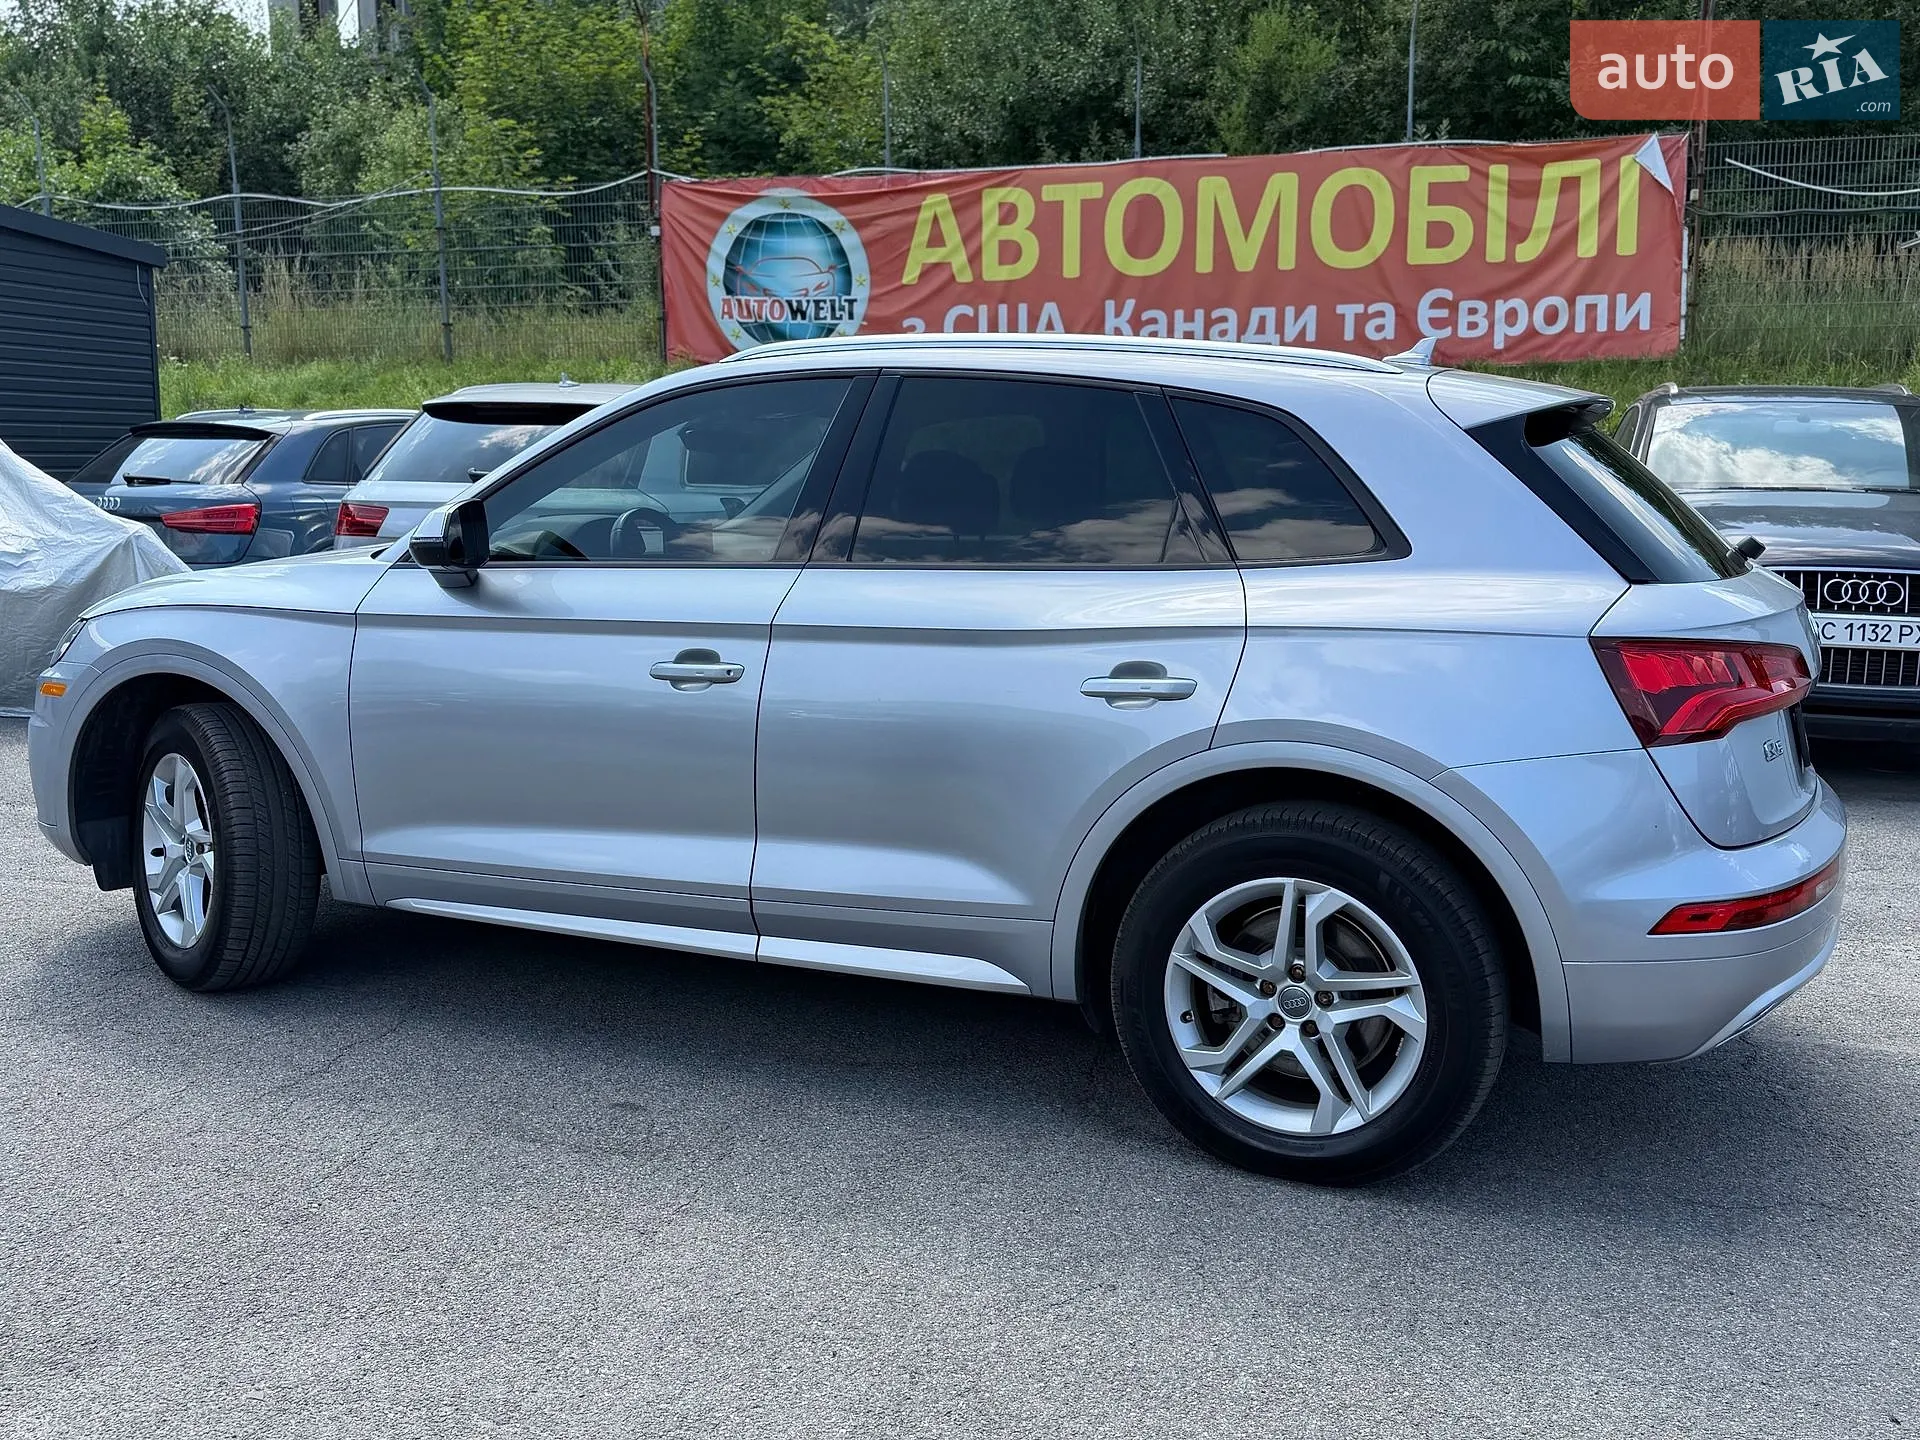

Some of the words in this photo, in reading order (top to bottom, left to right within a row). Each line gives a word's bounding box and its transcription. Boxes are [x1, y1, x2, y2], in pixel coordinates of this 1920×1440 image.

[902, 157, 1642, 284] АВТОМОБІЛІ
[720, 297, 857, 321] AUTOWELT
[1104, 299, 1317, 345] Канади
[1336, 301, 1396, 341] та
[1417, 288, 1651, 349] Європи
[1815, 621, 1836, 640] C
[1844, 622, 1892, 642] 1132
